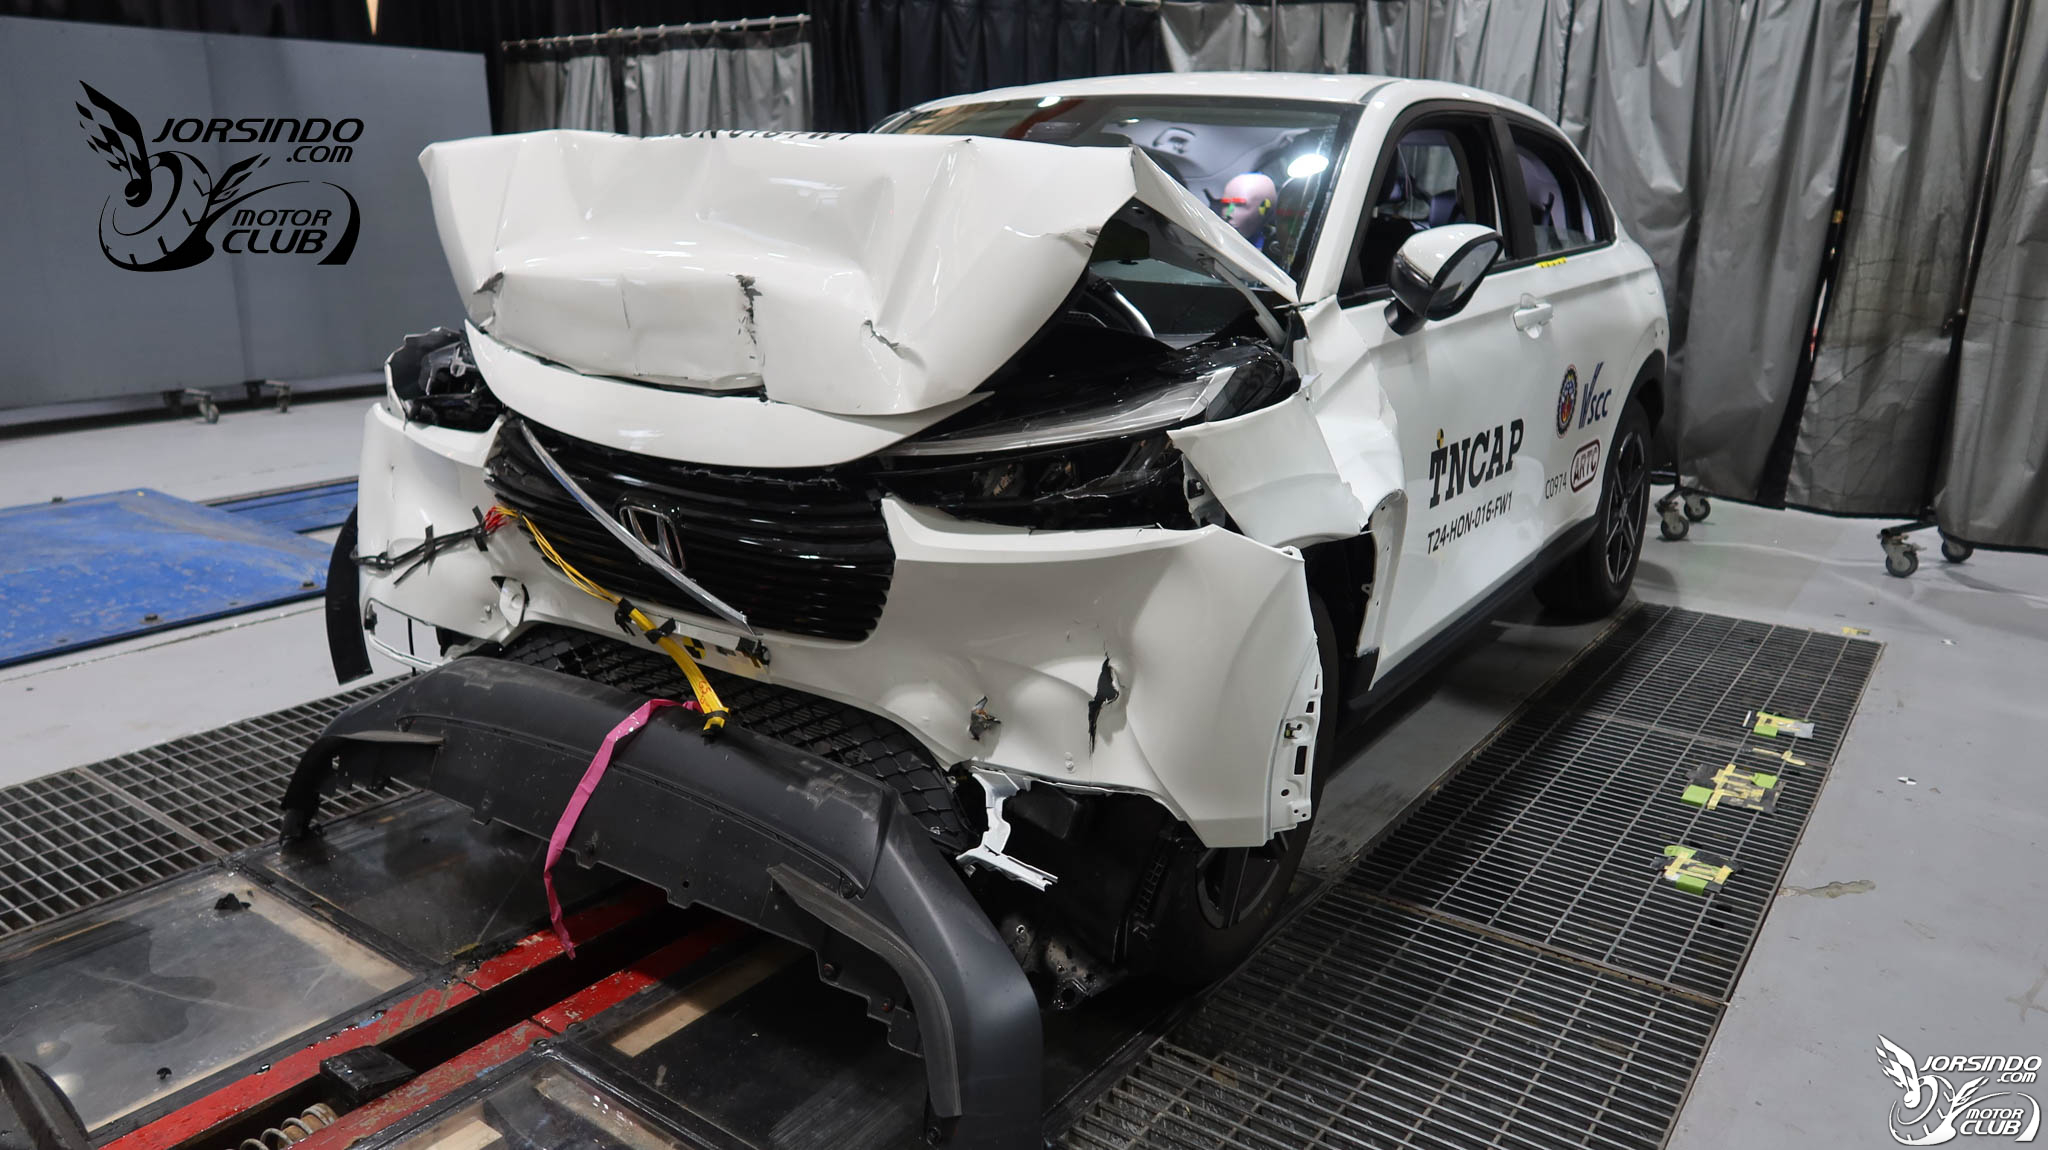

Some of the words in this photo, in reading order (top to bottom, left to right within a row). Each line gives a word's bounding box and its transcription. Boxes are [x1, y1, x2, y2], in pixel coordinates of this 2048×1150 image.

[1429, 418, 1524, 509] TNCAP
[1573, 446, 1597, 485] ARTC
[1427, 491, 1513, 554] T24-HON-016-FW1
